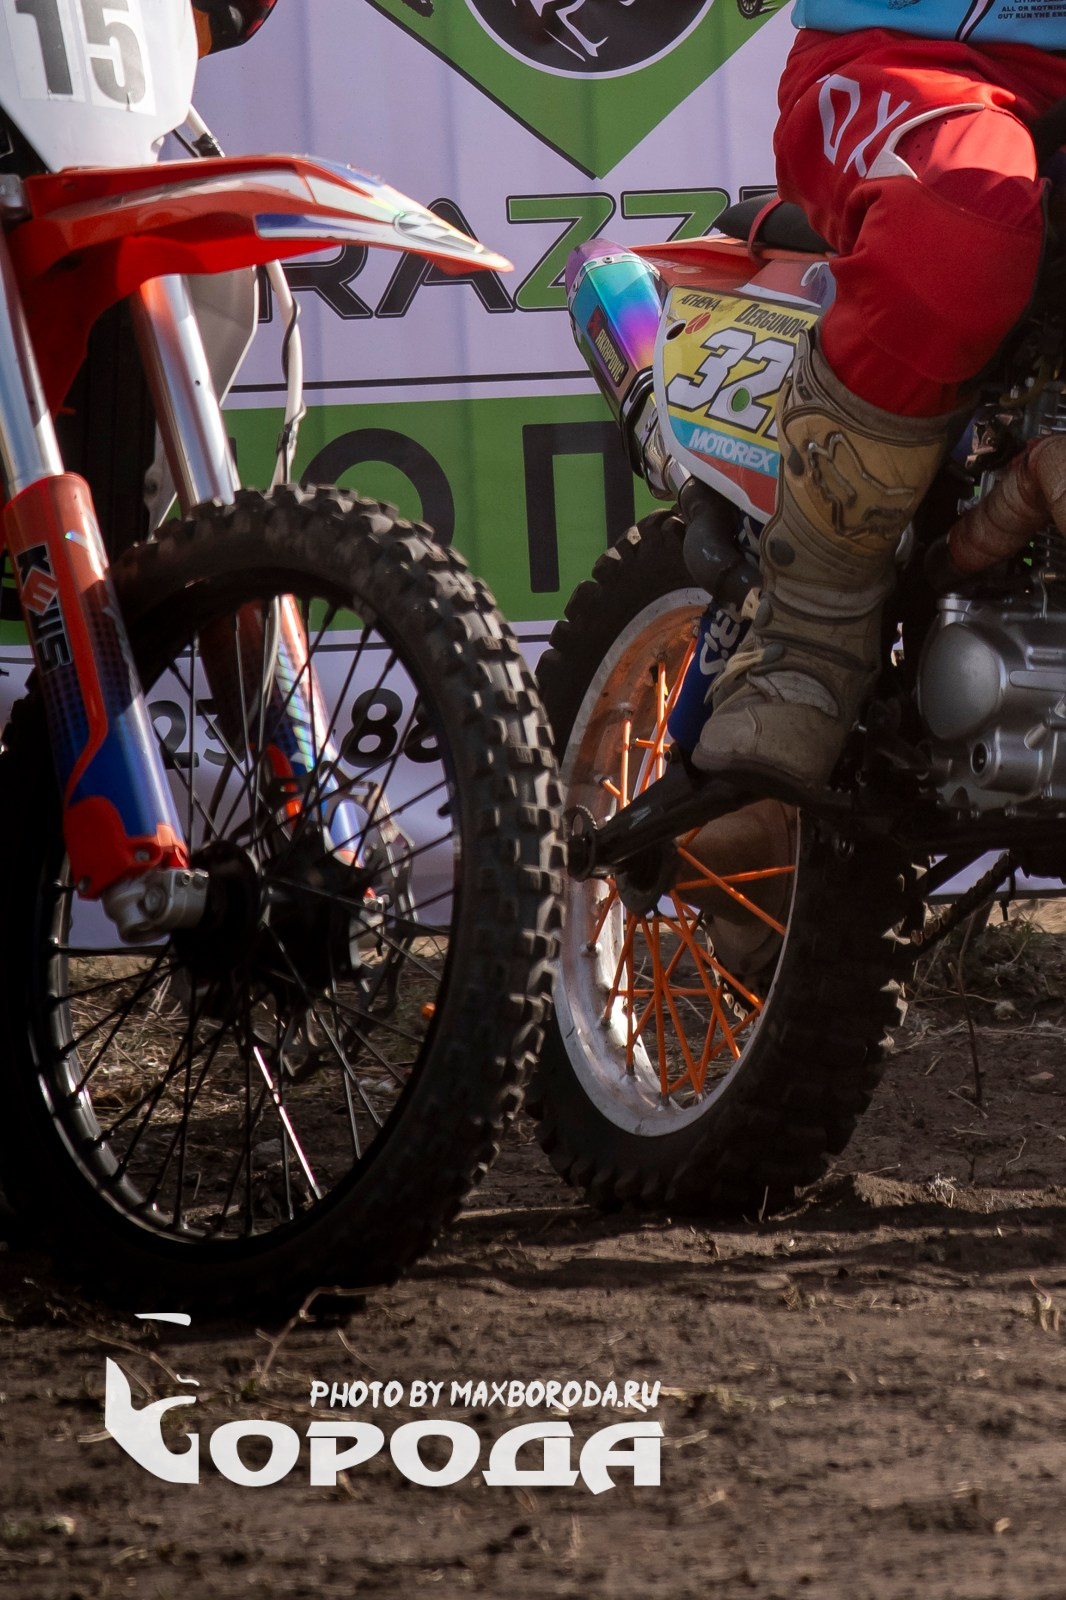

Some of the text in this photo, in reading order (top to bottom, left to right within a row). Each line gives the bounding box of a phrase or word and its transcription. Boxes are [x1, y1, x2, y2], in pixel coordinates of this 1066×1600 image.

[678, 294, 722, 312] ATHENA
[666, 326, 798, 440] 32
[689, 428, 777, 472] MOTOREX
